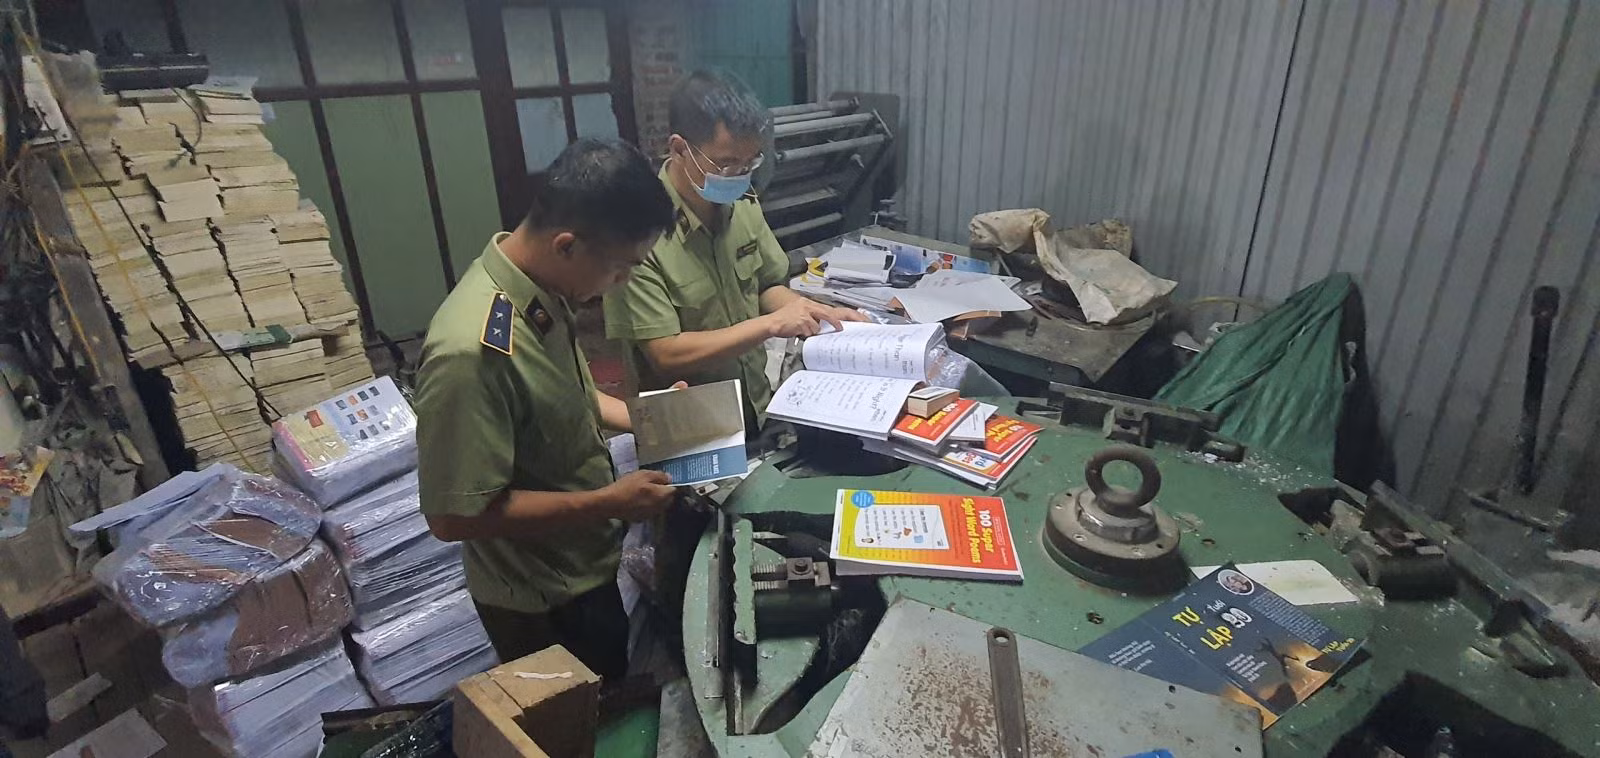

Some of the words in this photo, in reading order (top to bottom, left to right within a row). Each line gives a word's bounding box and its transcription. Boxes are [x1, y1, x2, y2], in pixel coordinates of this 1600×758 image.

[960, 498, 976, 515] Sight
[965, 516, 980, 537] Word
[978, 509, 992, 527] 100
[968, 537, 982, 563] Poems
[980, 527, 995, 553] Super
